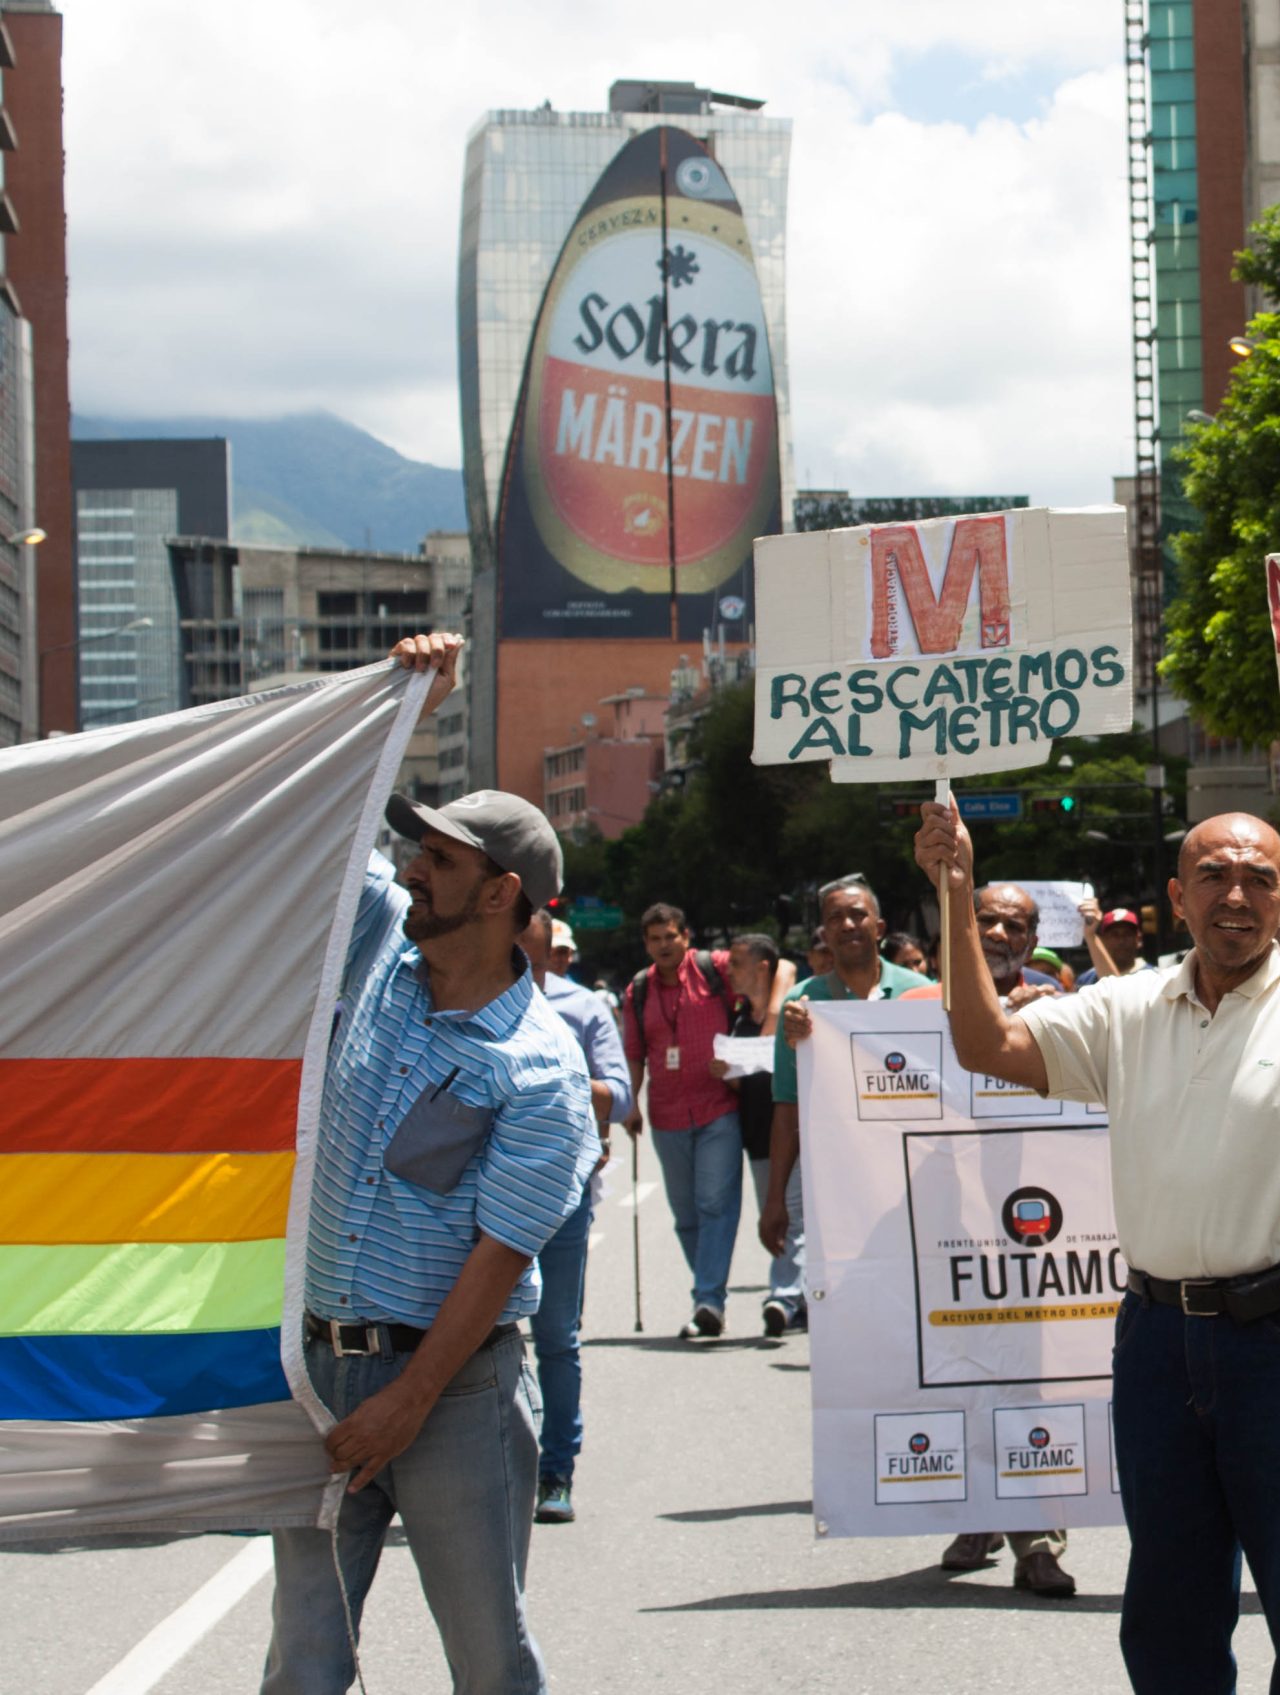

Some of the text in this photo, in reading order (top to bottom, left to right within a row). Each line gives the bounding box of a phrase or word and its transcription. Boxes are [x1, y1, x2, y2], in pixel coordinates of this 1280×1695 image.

[573, 292, 757, 382] Solera
[556, 384, 754, 485] MÄRZEN
[771, 646, 1125, 719] RESCATEMOS
[788, 689, 1080, 759] AL METRO
[866, 1074, 930, 1092] FUTAMC
[938, 1239, 974, 1248] FRENTE
[977, 1238, 1008, 1248] UNIDO
[1066, 1234, 1077, 1243] DE
[950, 1248, 1129, 1302] FUTAMC
[941, 1310, 992, 1322] ACTIVOS
[998, 1310, 1019, 1320] DEL
[1024, 1308, 1066, 1319] METRO
[1071, 1307, 1086, 1316] DE
[888, 1455, 954, 1475] FUTAMC
[1008, 1449, 1074, 1469] FUTAMC
